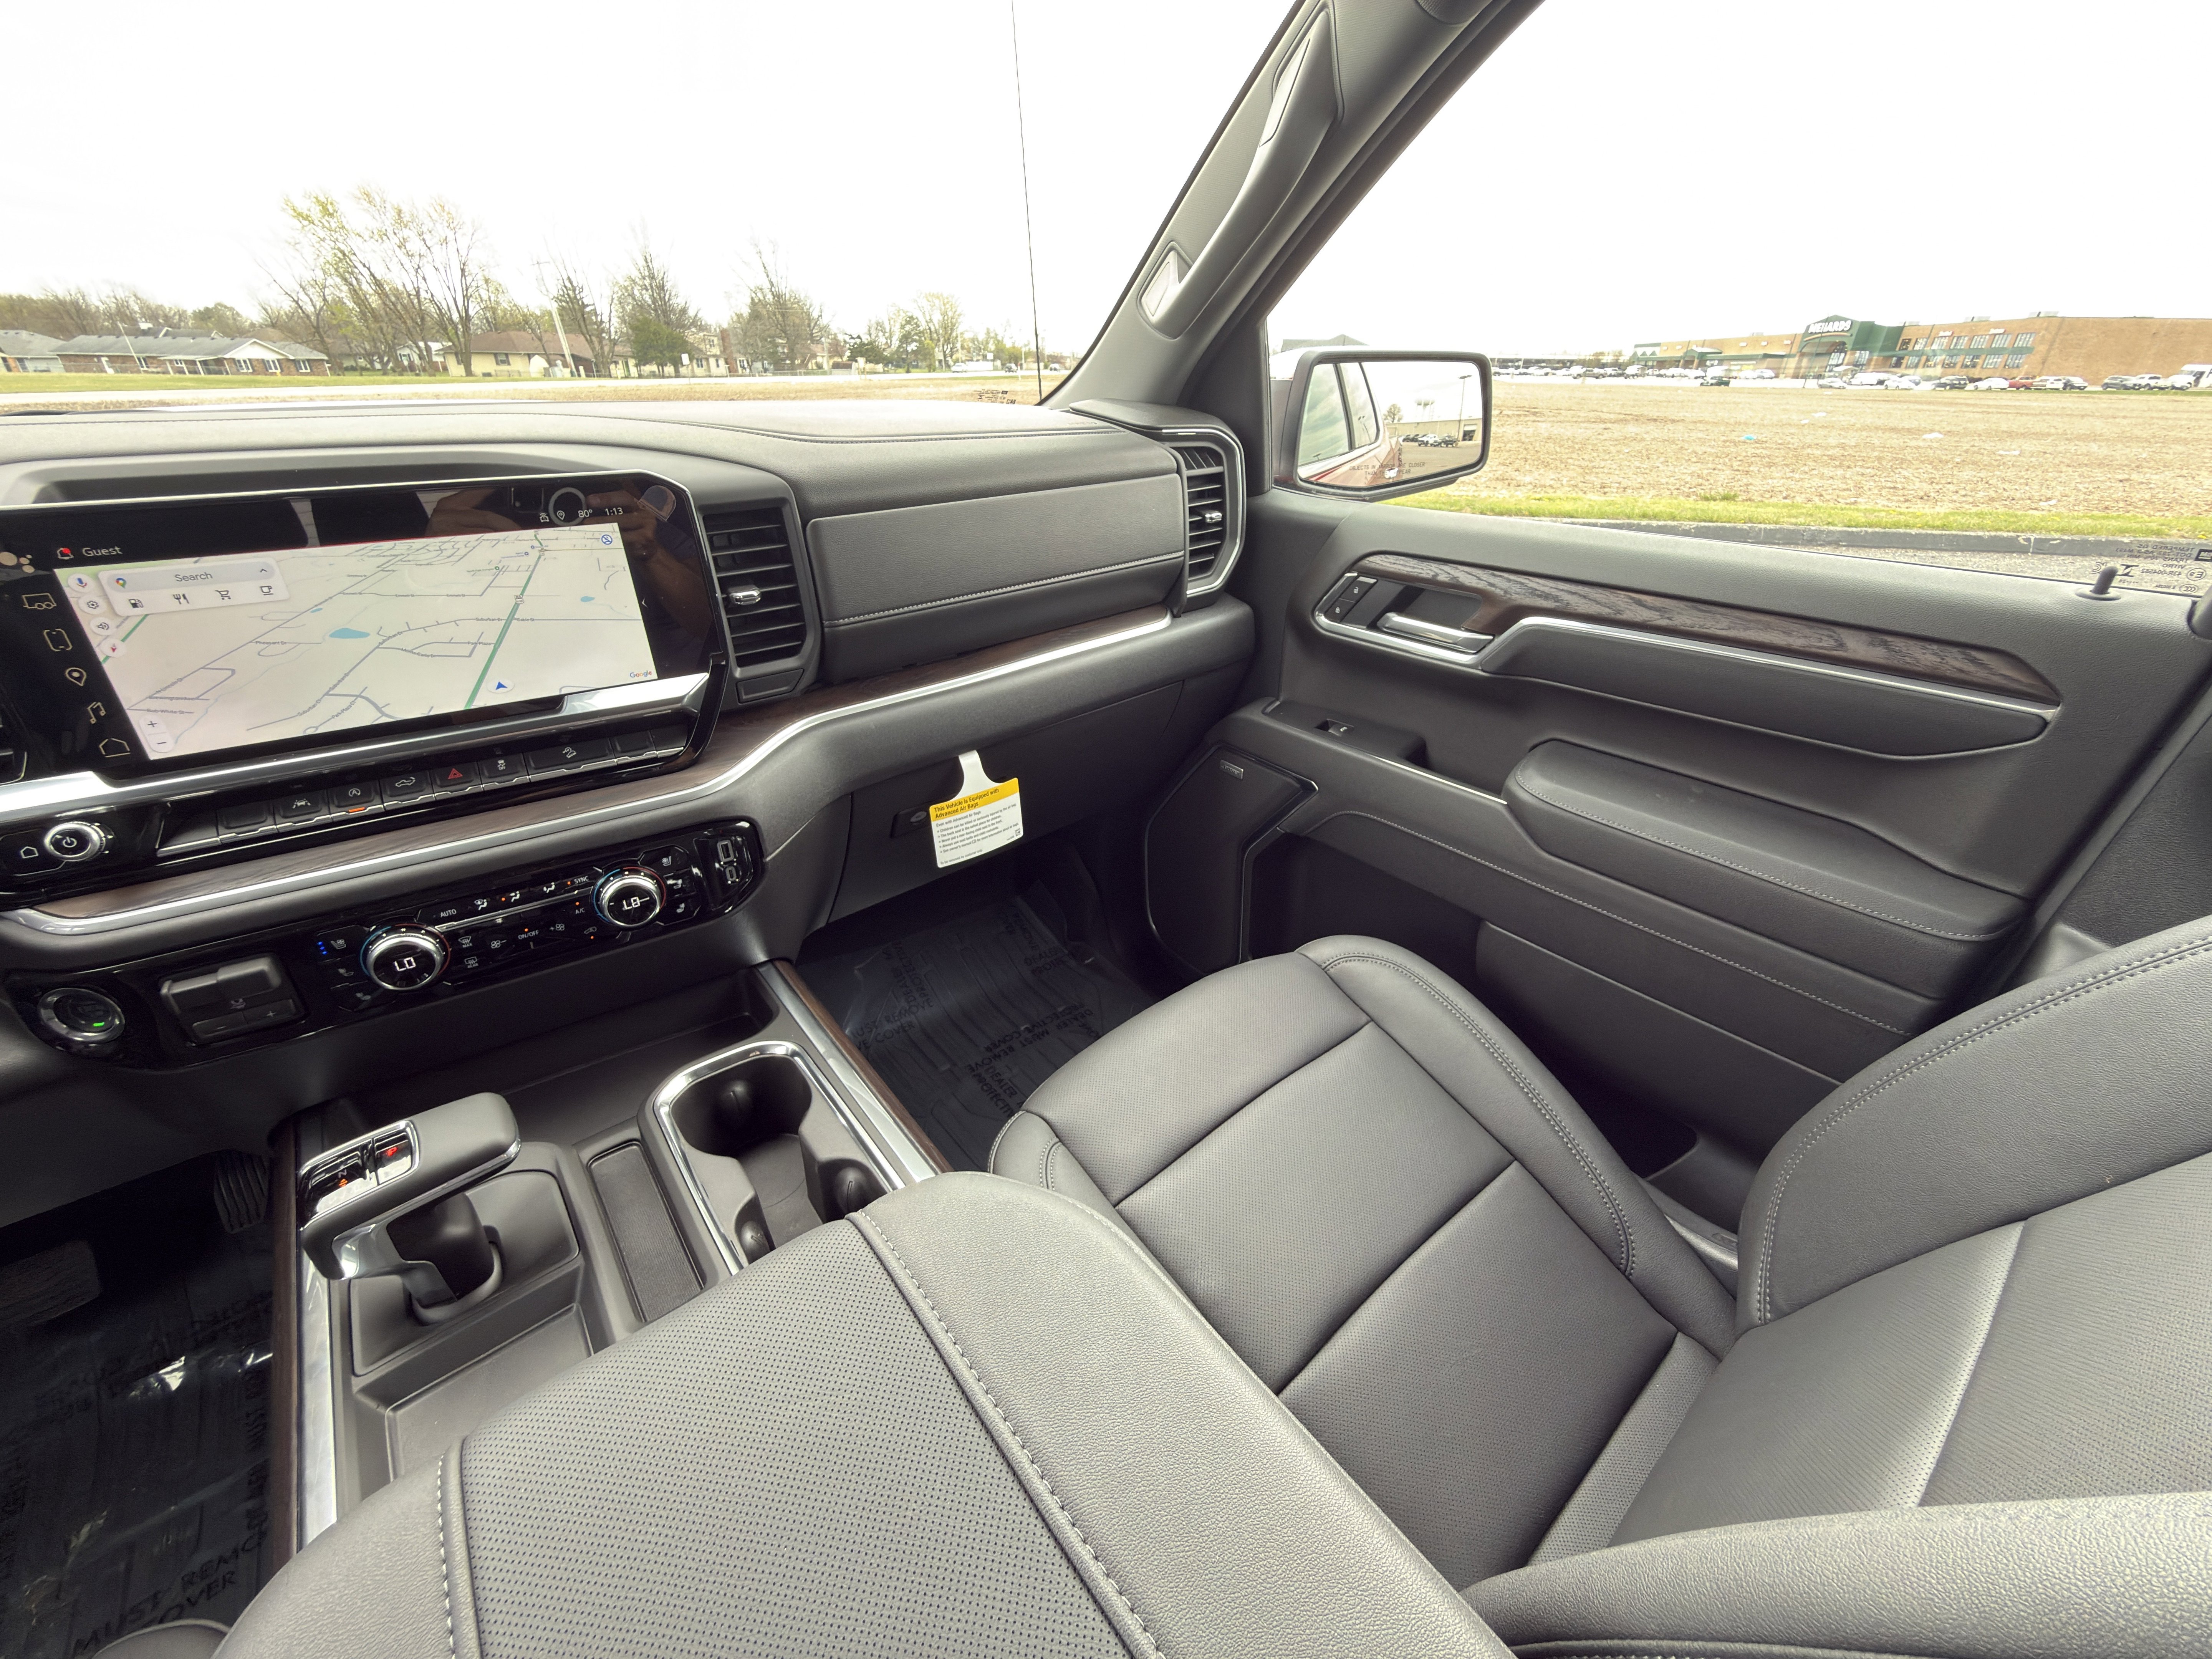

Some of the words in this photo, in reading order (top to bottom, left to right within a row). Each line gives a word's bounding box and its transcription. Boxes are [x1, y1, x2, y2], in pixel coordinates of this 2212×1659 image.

[578, 509, 593, 518] 80°
[605, 507, 623, 516] 1:13
[82, 546, 123, 556] Guest
[175, 572, 213, 582] Search
[946, 801, 963, 810] Vehicle
[969, 793, 989, 803] Equipped
[935, 809, 959, 819] Advanced
[574, 876, 589, 884] SYNC
[440, 909, 457, 917] AUTO
[518, 930, 539, 940] ON/OFF
[884, 998, 934, 1024] REMOVE
[1056, 1008, 1094, 1030] DEALER
[875, 1021, 915, 1043] COVER
[1018, 1028, 1050, 1048] MUST
[983, 1030, 1022, 1053] COVER
[964, 1045, 1015, 1074] REMOVE
[984, 1066, 1018, 1098] DEALER
[972, 1072, 1015, 1118] PROTECTIV
[387, 1147, 398, 1156] P
[338, 1169, 347, 1179] N
[141, 1570, 235, 1628] OVER
